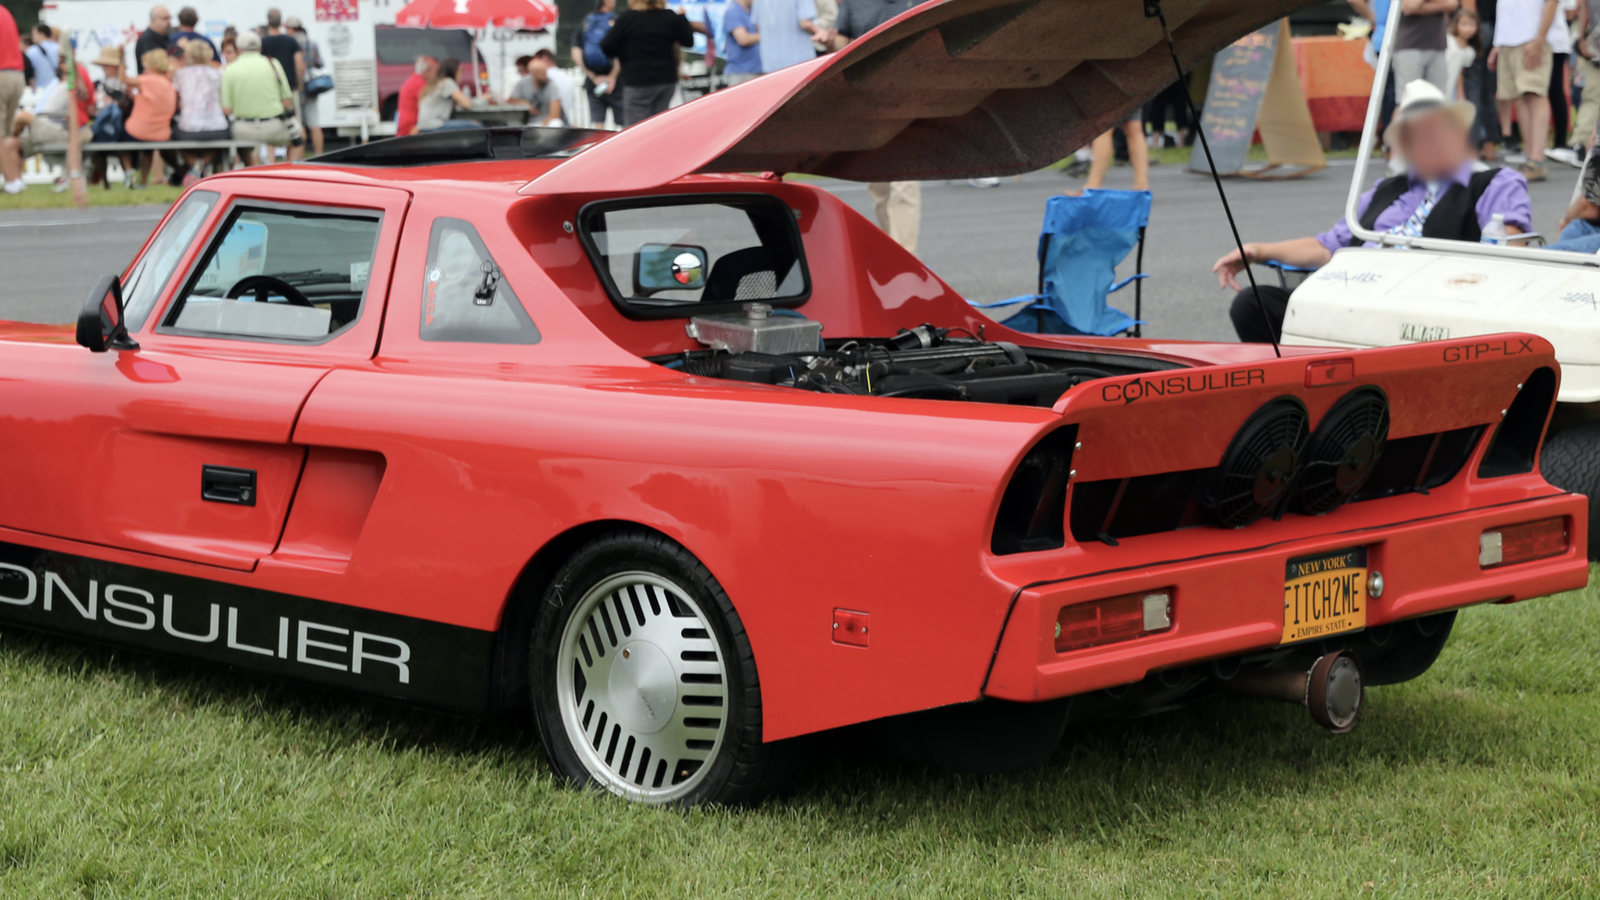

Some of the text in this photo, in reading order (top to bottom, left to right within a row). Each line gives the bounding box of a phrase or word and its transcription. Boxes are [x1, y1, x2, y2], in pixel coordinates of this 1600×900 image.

[425, 281, 437, 327] SCCA
[1399, 323, 1450, 342] YAMAHA
[1443, 338, 1534, 363] GTP-LX
[1102, 368, 1265, 405] CONSULIER
[1298, 556, 1346, 576] NEW YORK
[1297, 618, 1347, 638] EMPIRE STATE
